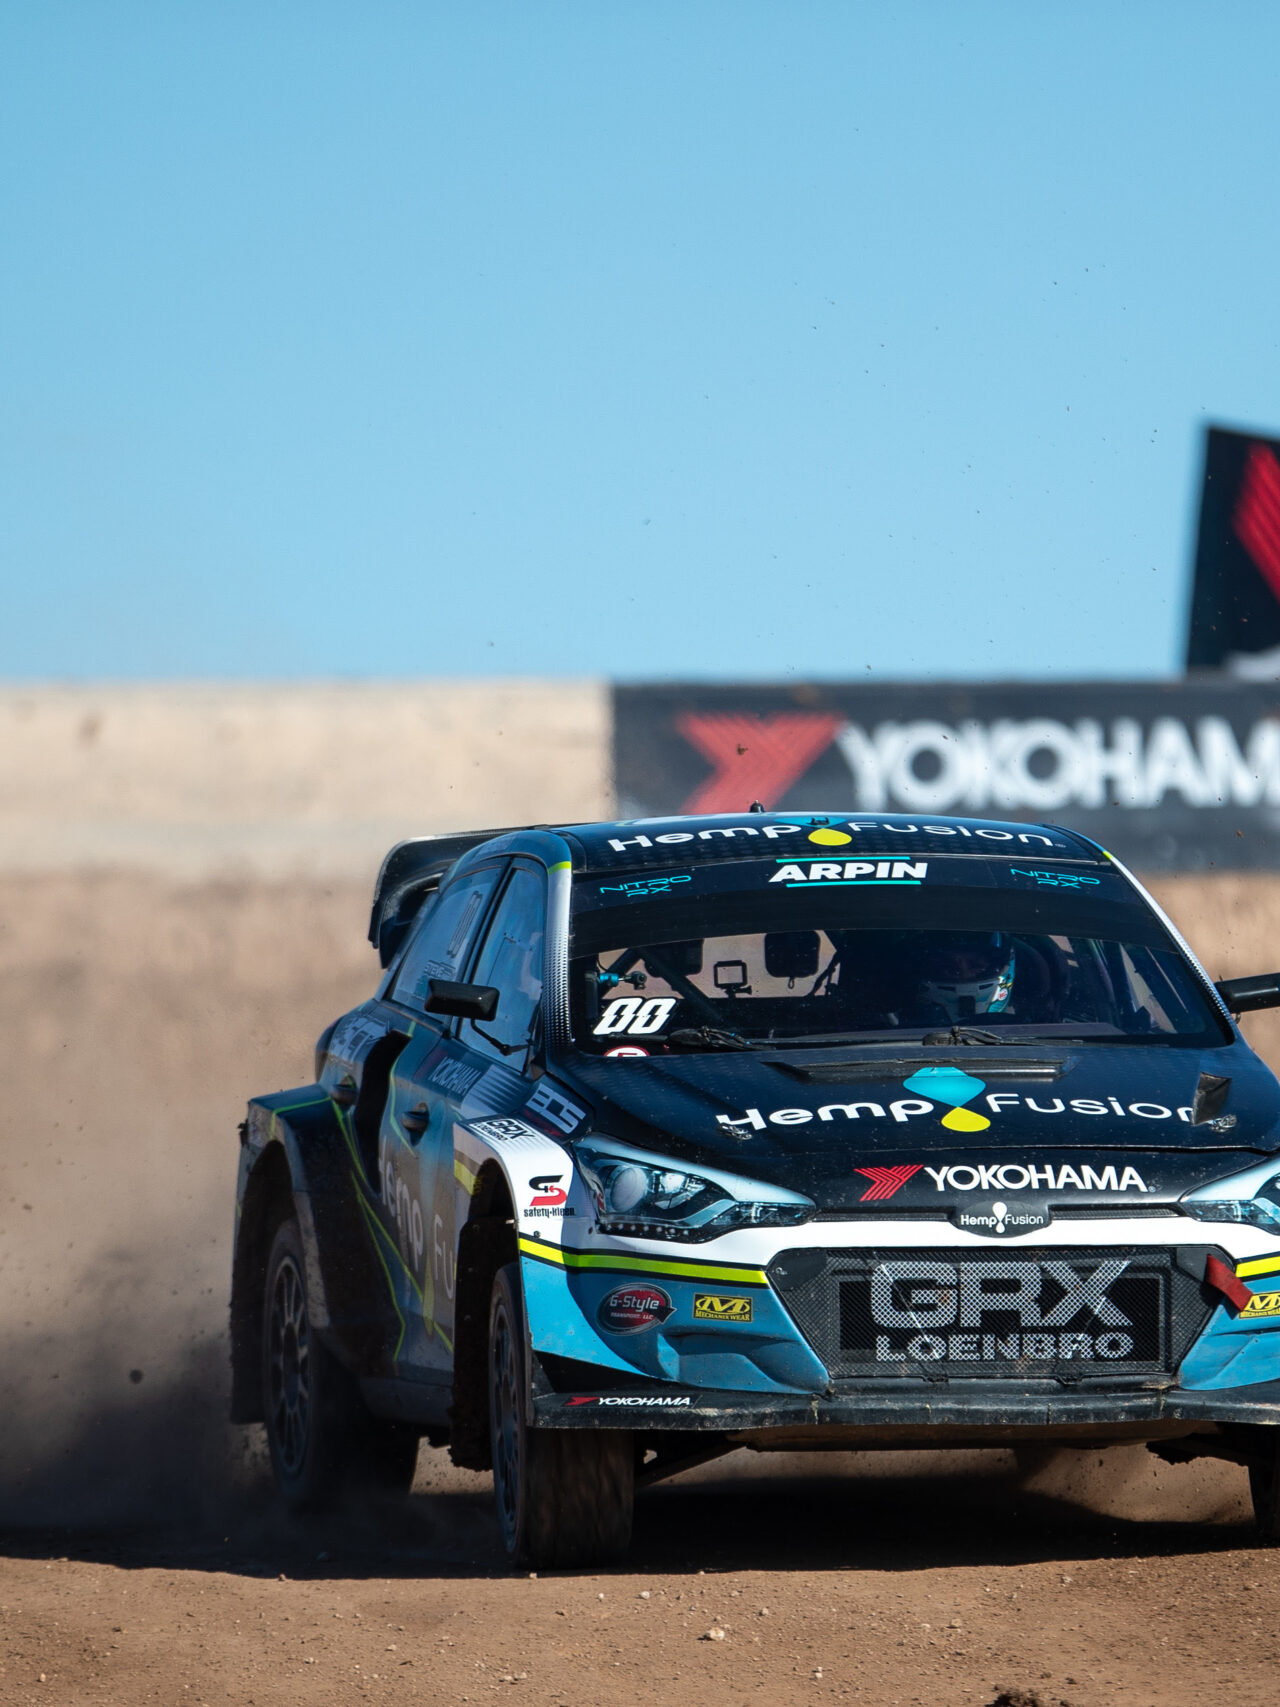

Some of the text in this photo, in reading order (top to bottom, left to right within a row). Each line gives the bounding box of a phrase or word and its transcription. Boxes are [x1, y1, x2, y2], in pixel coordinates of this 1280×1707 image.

[608, 825, 801, 851] Hemp
[769, 862, 928, 882] ARPIN
[1010, 868, 1100, 885] NITRO
[600, 875, 692, 894] NITRO
[627, 884, 672, 897] RX
[1037, 878, 1081, 889] RX
[593, 998, 676, 1035] 00
[715, 1100, 934, 1130] Hemp
[924, 1164, 1148, 1191] YOKOHAMA
[524, 1207, 575, 1218] safety-kleen
[961, 1213, 1044, 1227] Hemp Fusion
[610, 1295, 660, 1312] G-Style
[871, 1261, 1133, 1328] GRX
[876, 1332, 1134, 1361] LOENBRO
[598, 1397, 690, 1405] YOKOHAMA
